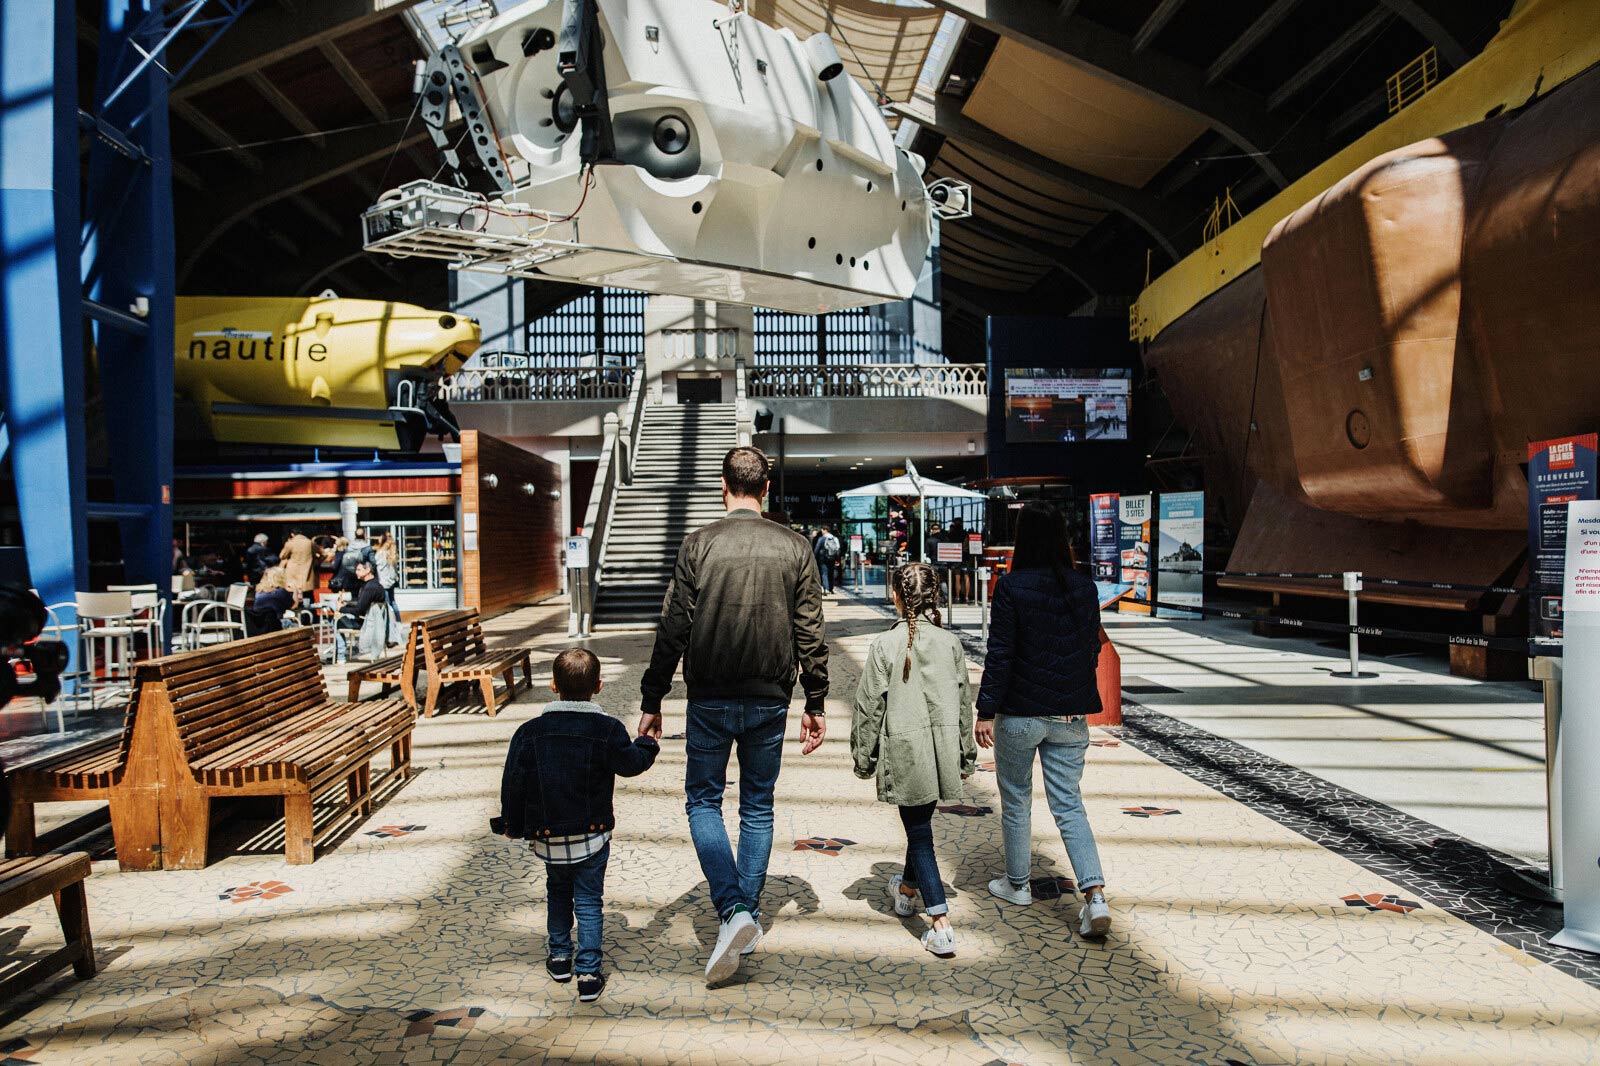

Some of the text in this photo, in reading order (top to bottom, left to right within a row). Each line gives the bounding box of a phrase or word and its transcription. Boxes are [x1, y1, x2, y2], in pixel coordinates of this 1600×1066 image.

[189, 335, 327, 362] nautile
[1549, 441, 1574, 454] LA CITÉ
[1537, 470, 1585, 482] BIENVENUE
[1125, 499, 1145, 508] BILLET
[1130, 509, 1145, 517] SITES
[1449, 635, 1489, 646] La Cité de la Mer
